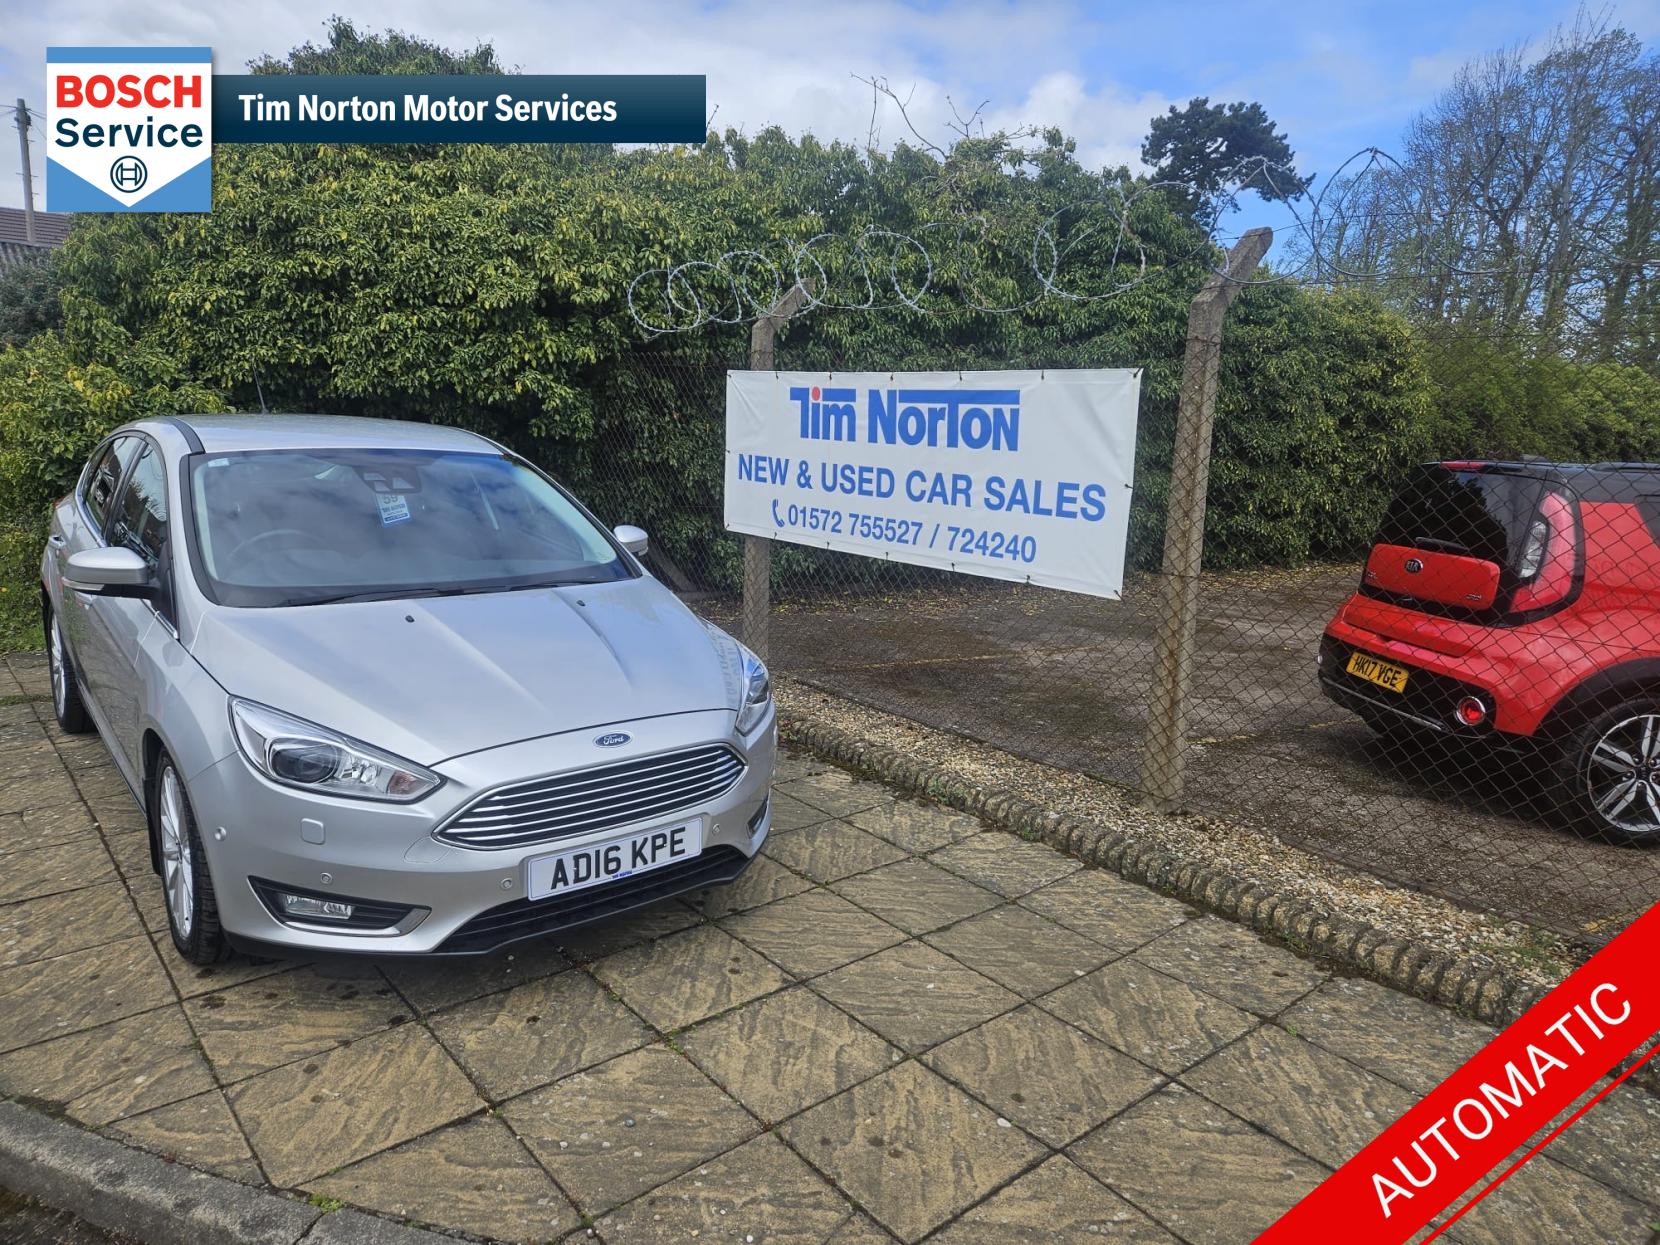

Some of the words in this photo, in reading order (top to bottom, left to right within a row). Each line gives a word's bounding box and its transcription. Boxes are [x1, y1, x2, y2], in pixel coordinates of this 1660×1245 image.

[790, 386, 857, 442] Tim
[738, 454, 789, 485] NEW
[797, 460, 812, 489] &
[821, 464, 896, 499] USED
[905, 470, 973, 507] CAR
[984, 476, 1106, 521] SALES
[788, 504, 842, 534] 01572
[849, 512, 924, 546] 755527
[929, 524, 940, 548] /
[947, 526, 1037, 563] 724240
[1353, 656, 1378, 677] HK17
[1377, 664, 1402, 687] VGE
[603, 734, 626, 745] Ford
[550, 844, 622, 890] AD16
[631, 826, 687, 869] KPE
